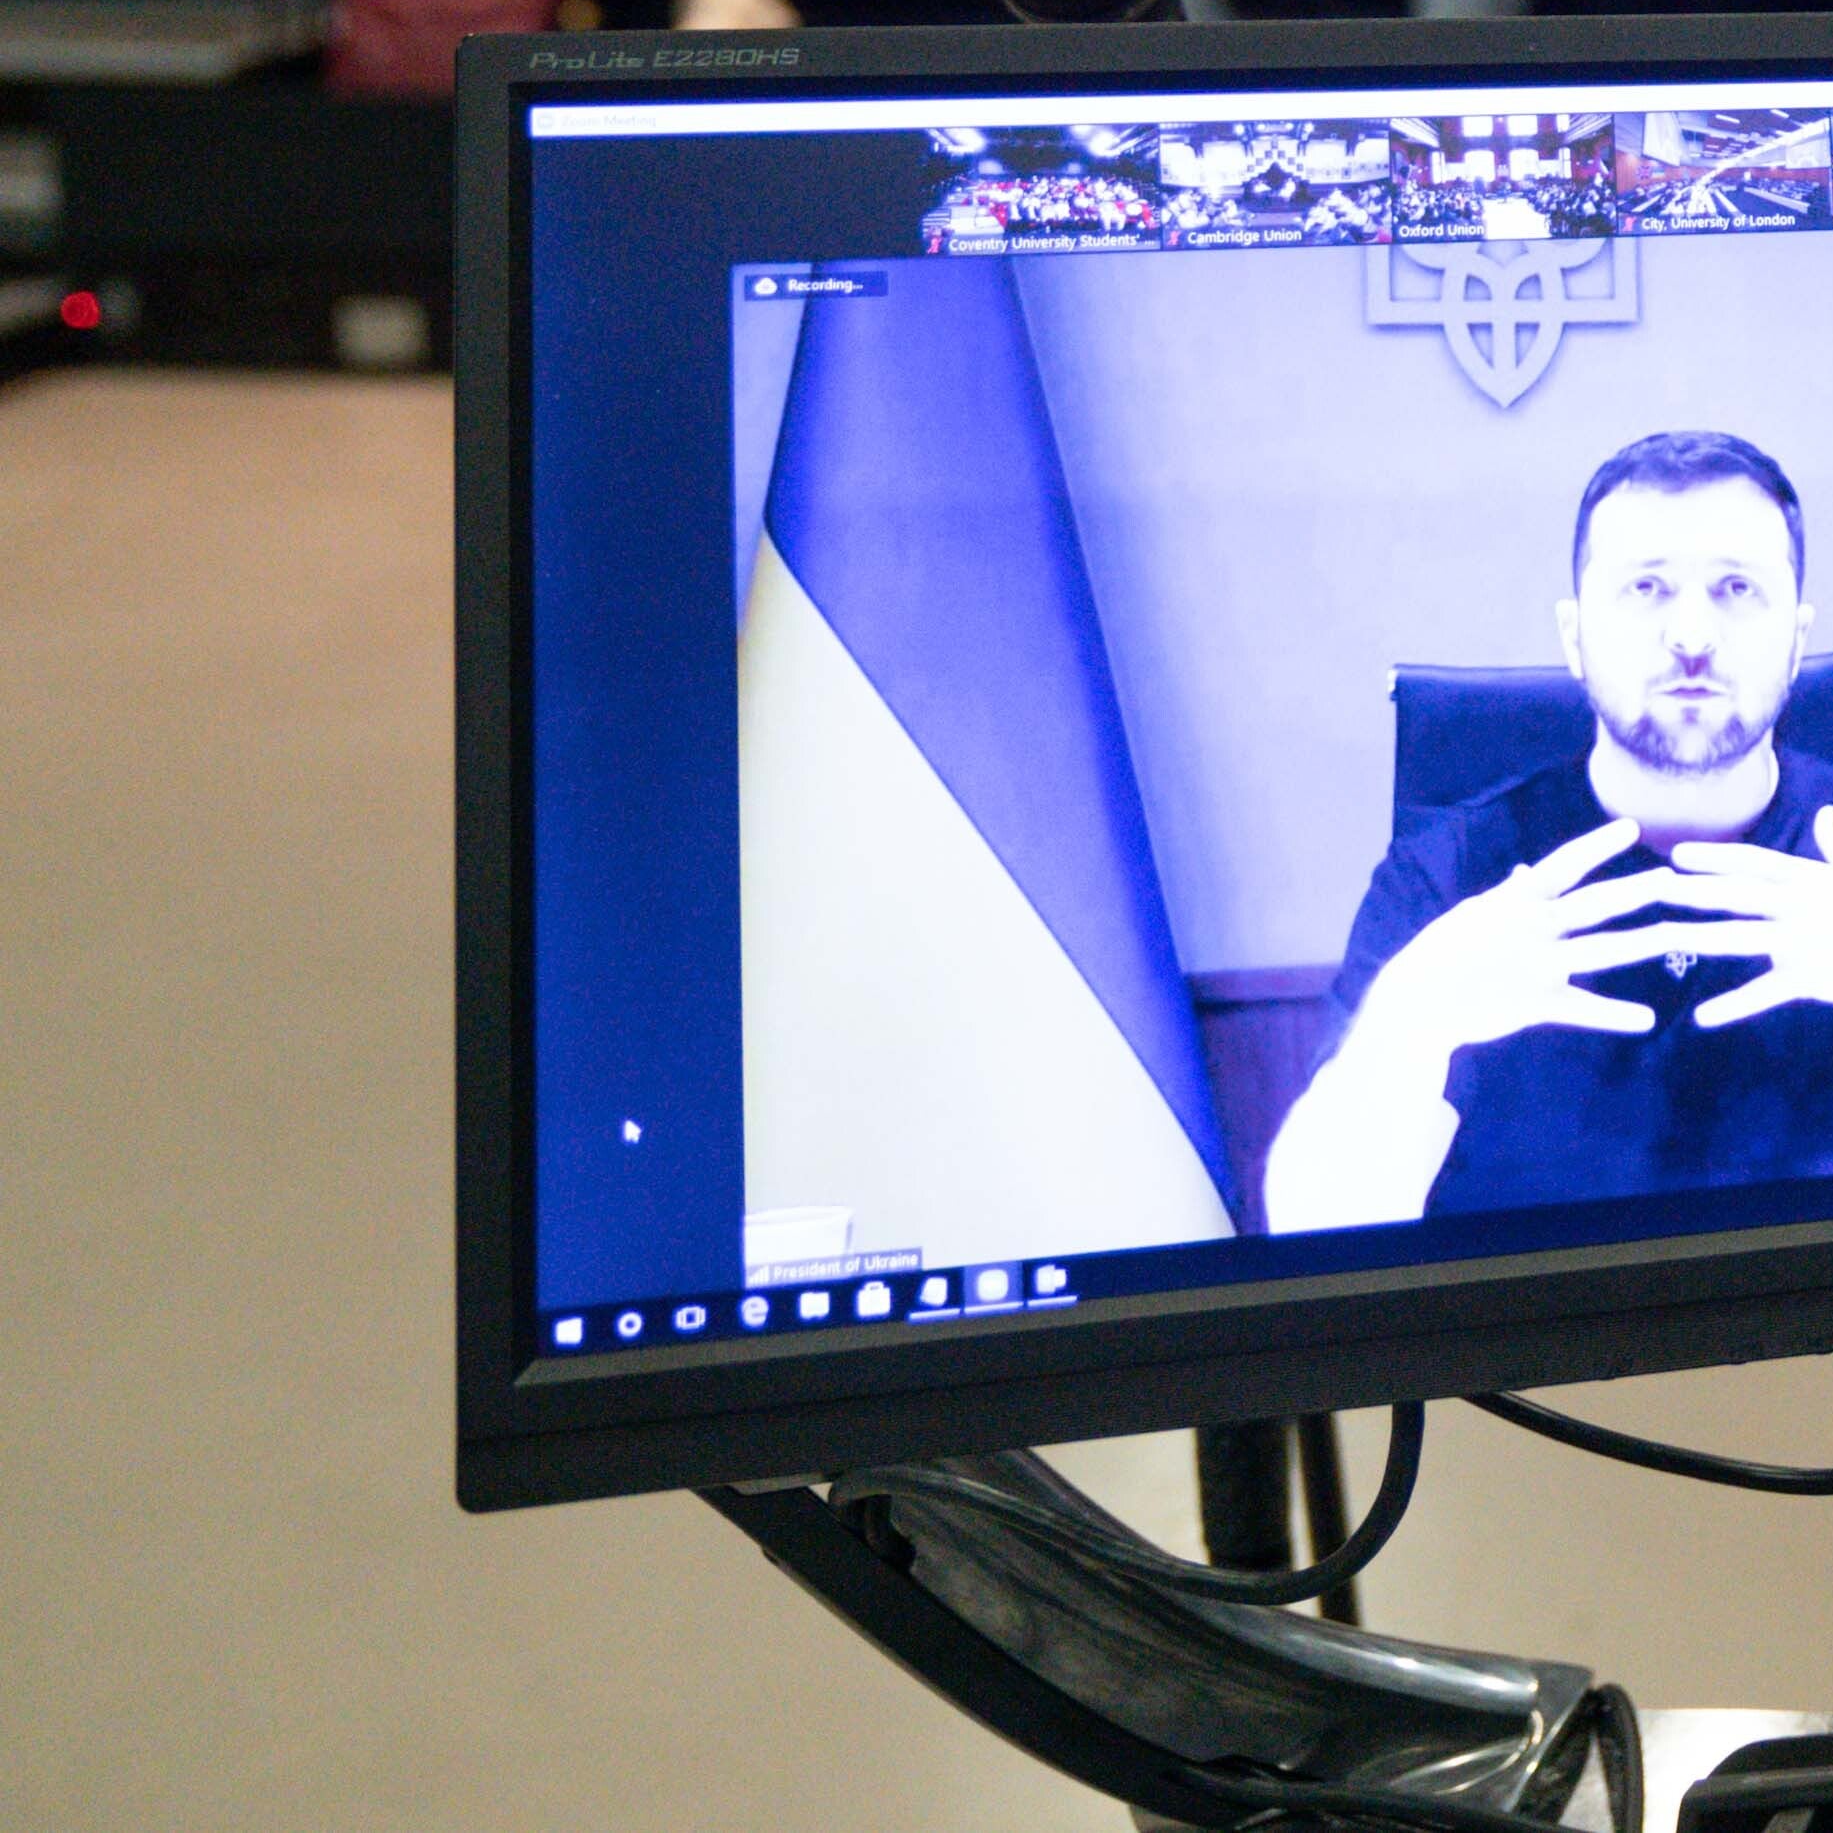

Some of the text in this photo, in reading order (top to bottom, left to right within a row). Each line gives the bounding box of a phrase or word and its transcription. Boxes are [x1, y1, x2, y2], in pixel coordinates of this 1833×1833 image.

[531, 48, 800, 69] ProLite E2280HS
[1400, 224, 1484, 238] Oxford Union
[1641, 214, 1796, 231] City, University of London
[949, 238, 1008, 253] Coventry
[1011, 236, 1077, 251] University
[1080, 233, 1140, 247] Students'
[1187, 228, 1302, 245] Cambridge Union
[788, 278, 864, 294] Recording...
[773, 1253, 919, 1280] President of Ukraine
